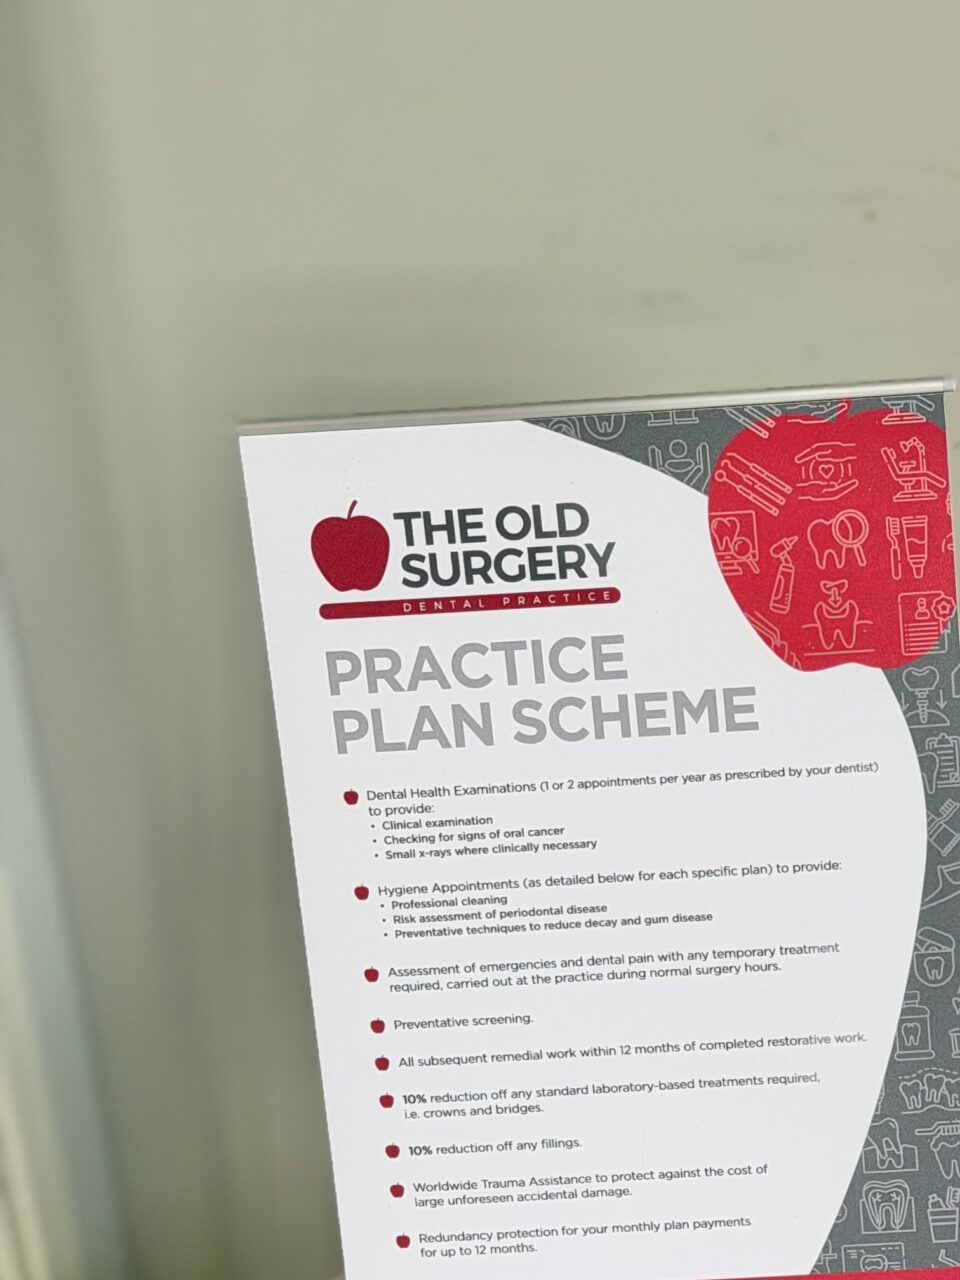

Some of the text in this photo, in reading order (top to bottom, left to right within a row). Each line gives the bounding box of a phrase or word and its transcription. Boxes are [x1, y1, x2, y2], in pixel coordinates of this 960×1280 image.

[393, 502, 589, 546] THE OLD
[401, 542, 615, 588] SURGERY
[403, 591, 610, 612] DENTAL PRACTICE
[325, 634, 628, 695] PRACTICE
[332, 686, 759, 754] PLAN SCHEME
[366, 761, 878, 800] Dental Health Examinations (1 or 2 appointments per year as prescribed by your dentist)
[368, 803, 434, 817] to provide:
[382, 816, 493, 830] Clinical examination
[383, 828, 564, 844] Checking for signs of oral cancer
[393, 1014, 533, 1030] Preventative screening.
[408, 1138, 581, 1156] 10% reduction off any fillings.
